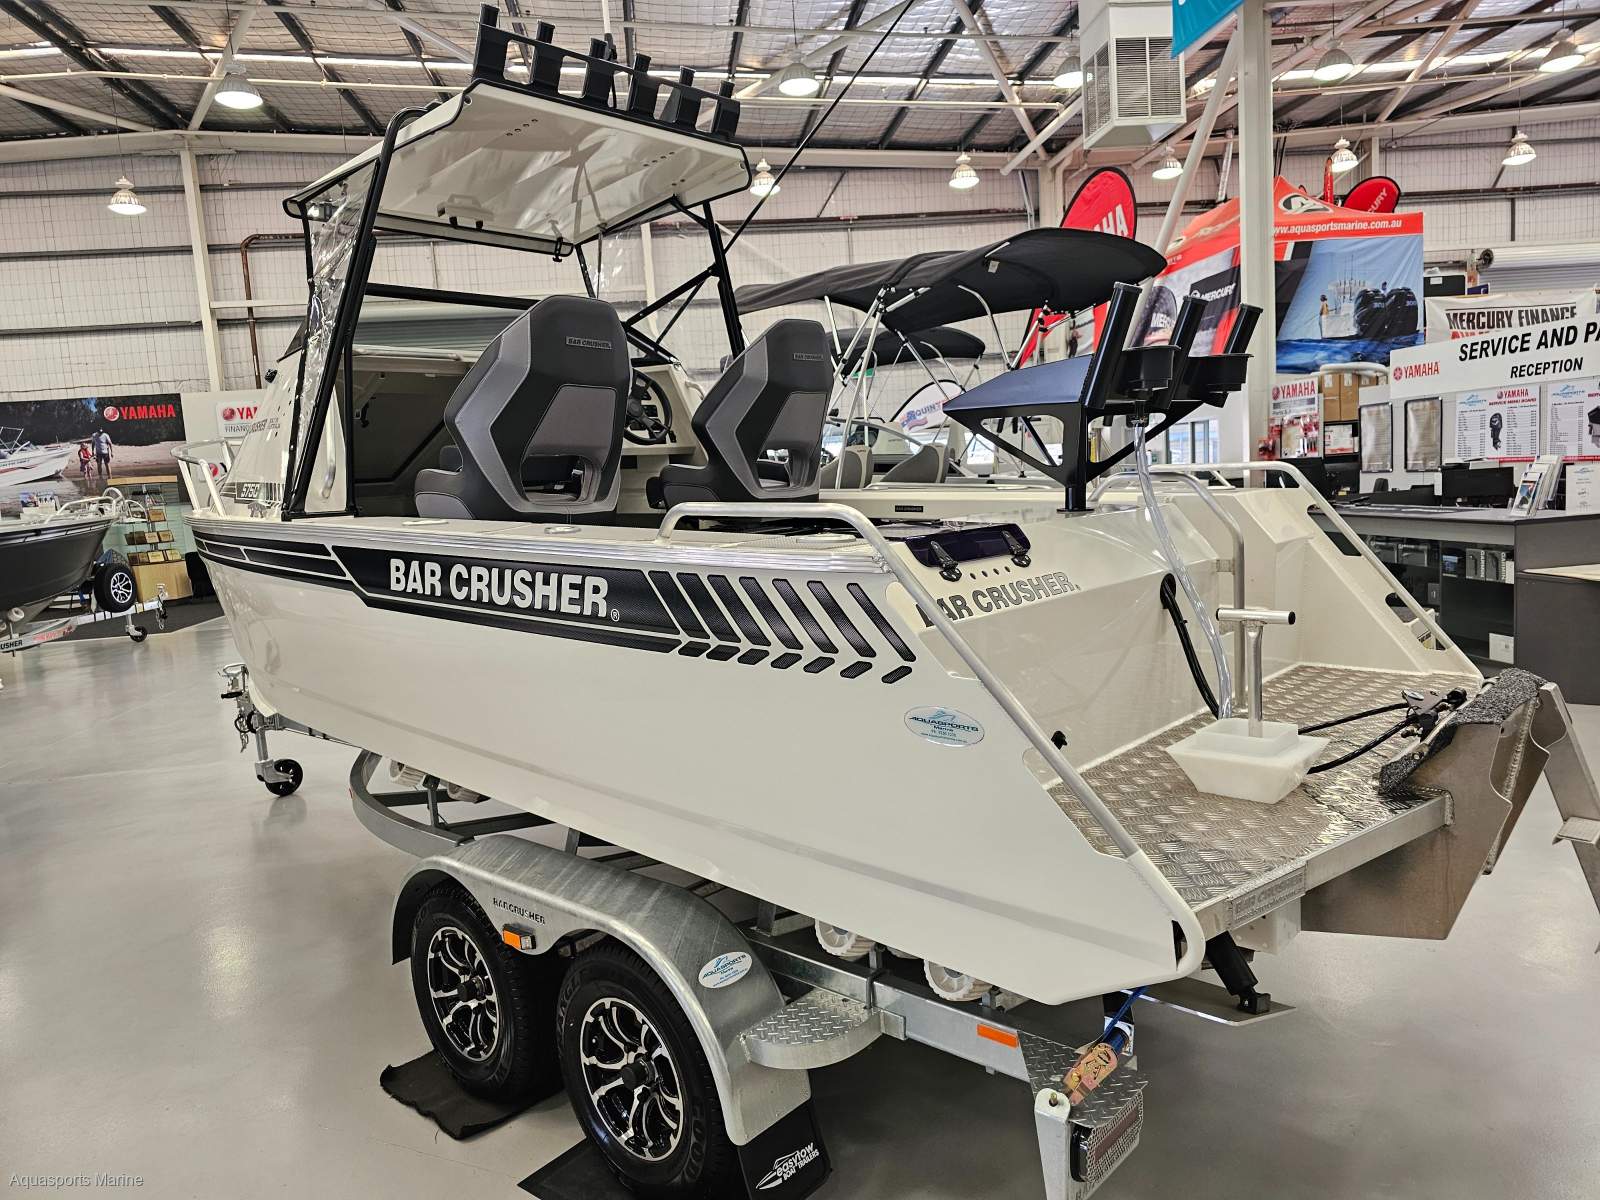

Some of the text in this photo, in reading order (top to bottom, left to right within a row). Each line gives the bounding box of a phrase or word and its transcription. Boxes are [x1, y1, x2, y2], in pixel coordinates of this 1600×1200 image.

[1446, 310, 1513, 330] MERCURY
[1458, 332, 1532, 361] SERVICE
[1536, 325, 1578, 350] AND
[1403, 361, 1440, 379] YAMAHA
[1510, 357, 1584, 379] RECEPTION
[1281, 380, 1316, 399] YAMAHA
[1504, 388, 1529, 398] YAMAHA
[120, 404, 176, 420] YAMAHA
[389, 558, 609, 618] BAR CRUSHER
[972, 571, 1075, 613] CRUSHER
[783, 1166, 797, 1181] BOAT
